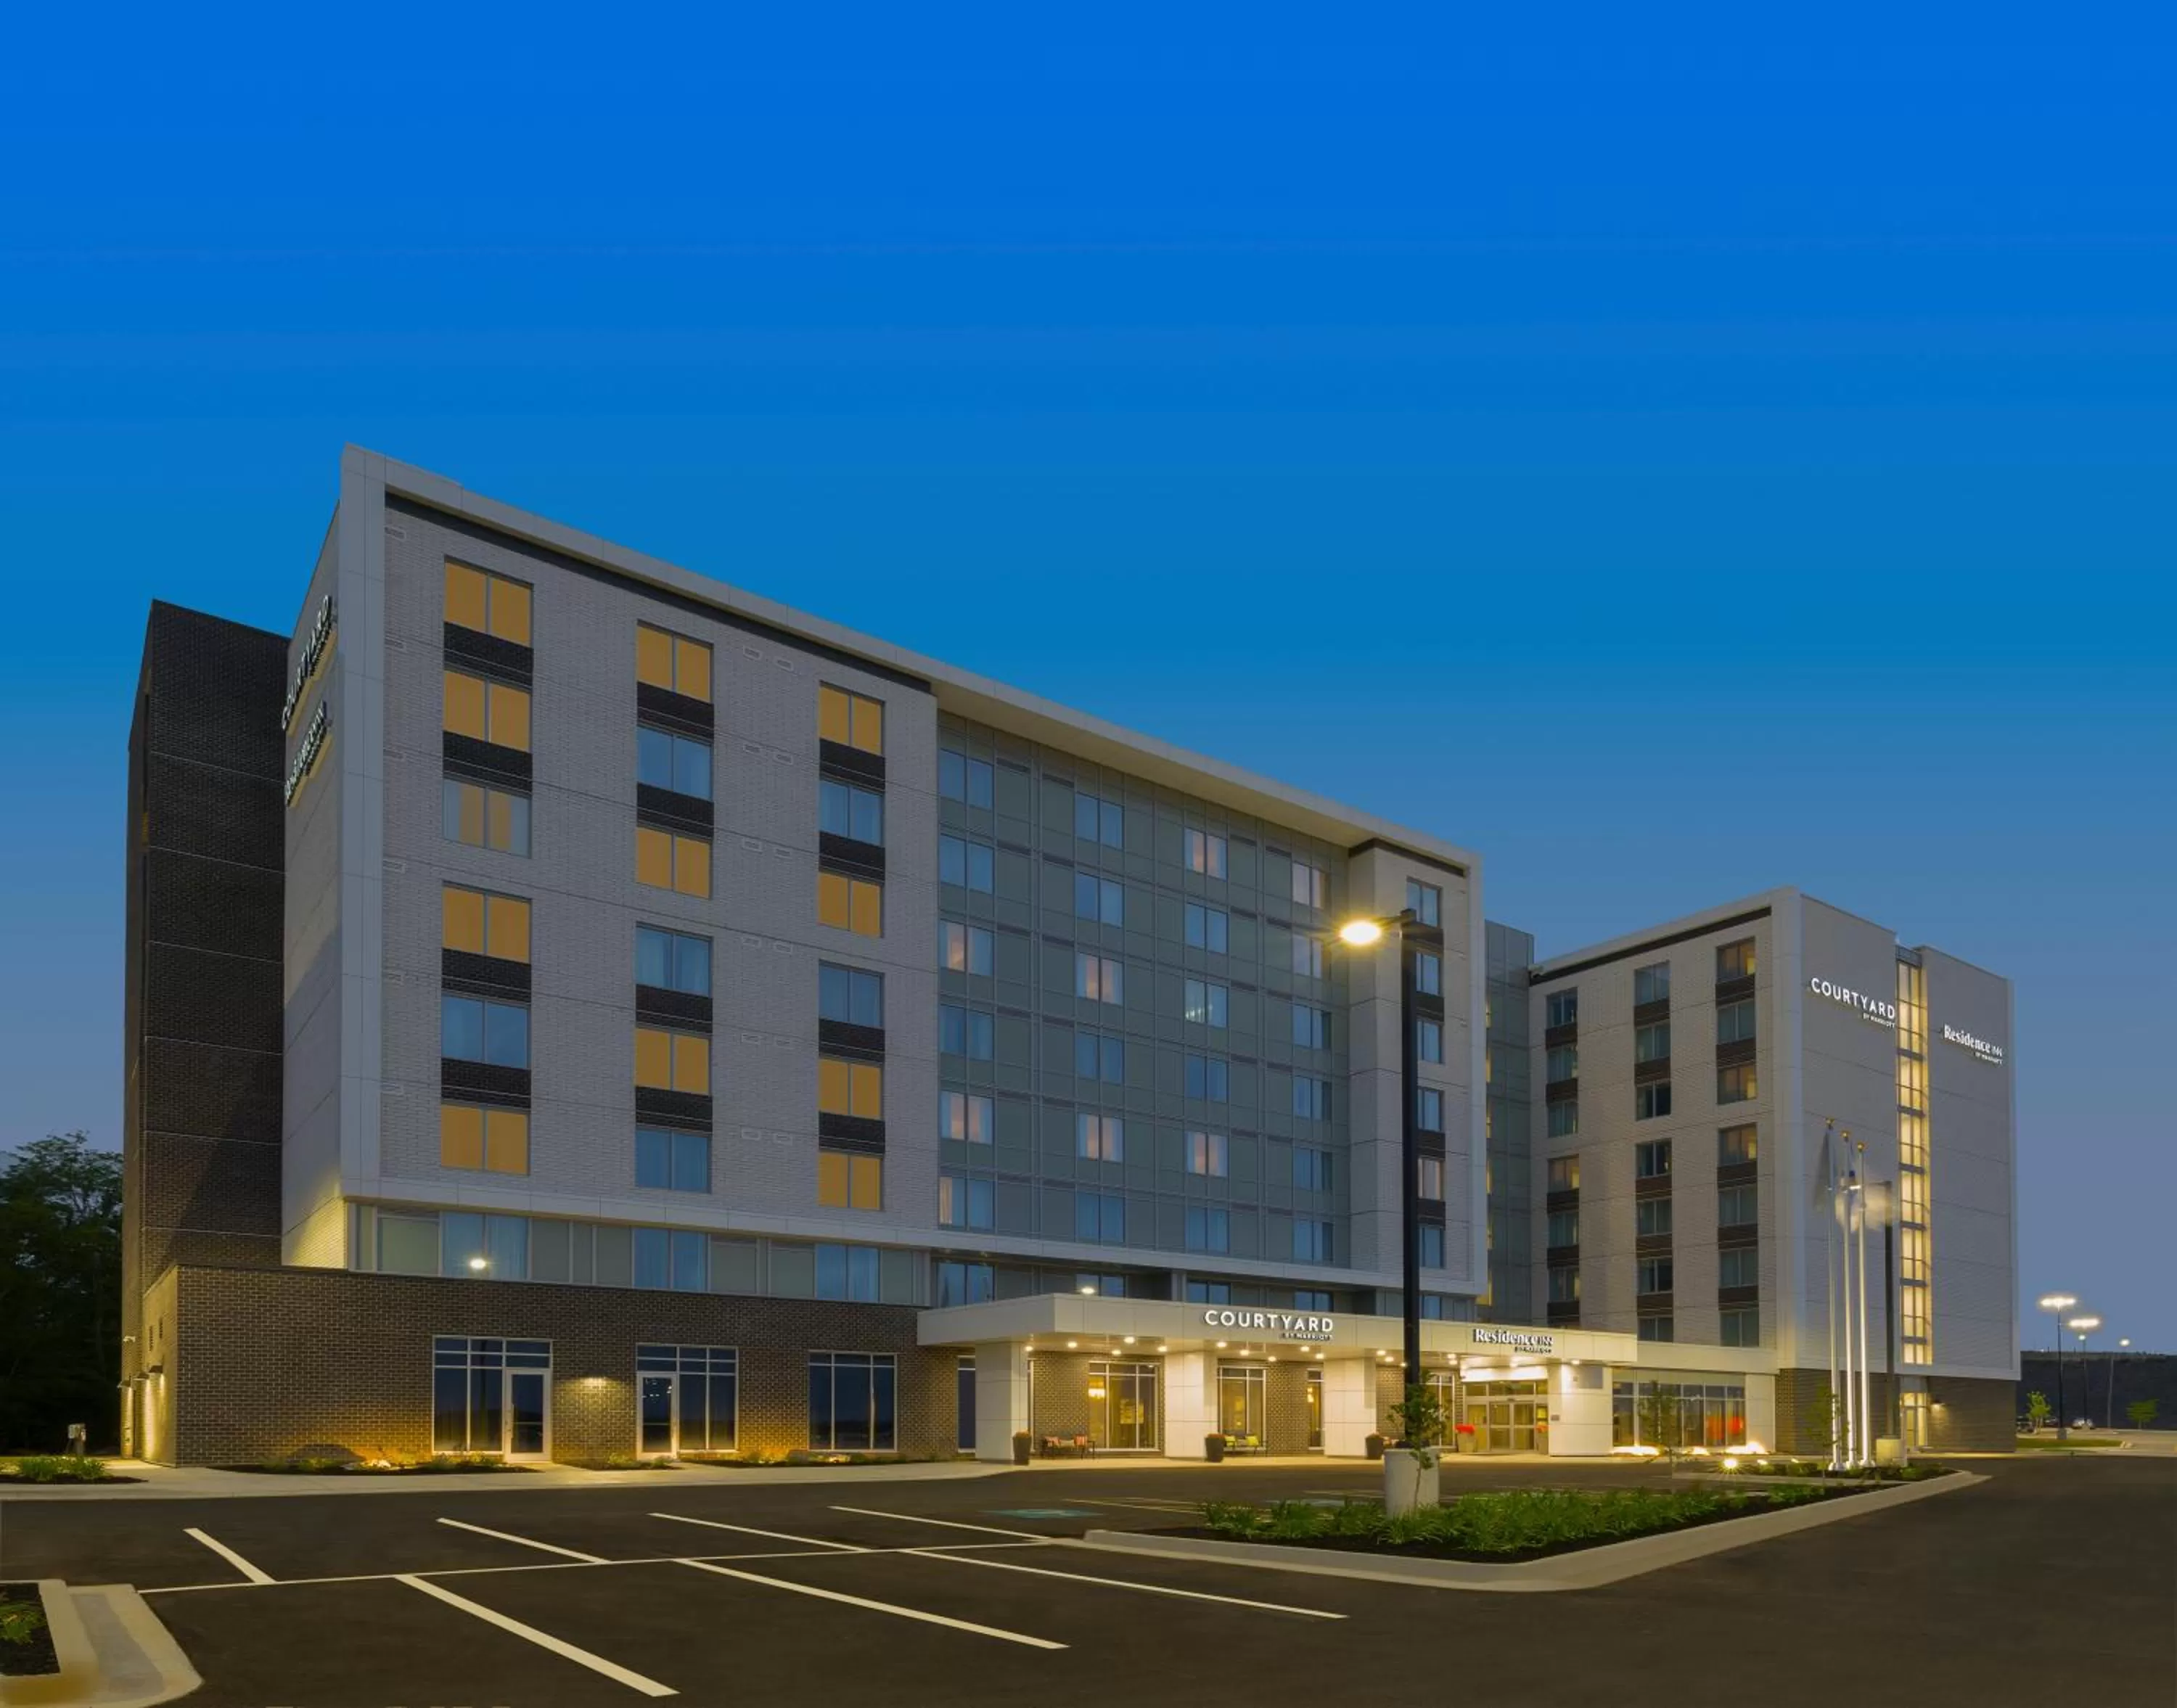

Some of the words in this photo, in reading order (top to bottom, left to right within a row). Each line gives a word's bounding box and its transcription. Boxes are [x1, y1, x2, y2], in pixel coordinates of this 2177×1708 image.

[1811, 977, 1895, 1019] COURTYARD
[1944, 1024, 1991, 1054] Residence
[1205, 1310, 1334, 1332] COURTYARD
[1475, 1329, 1538, 1344] Residence
